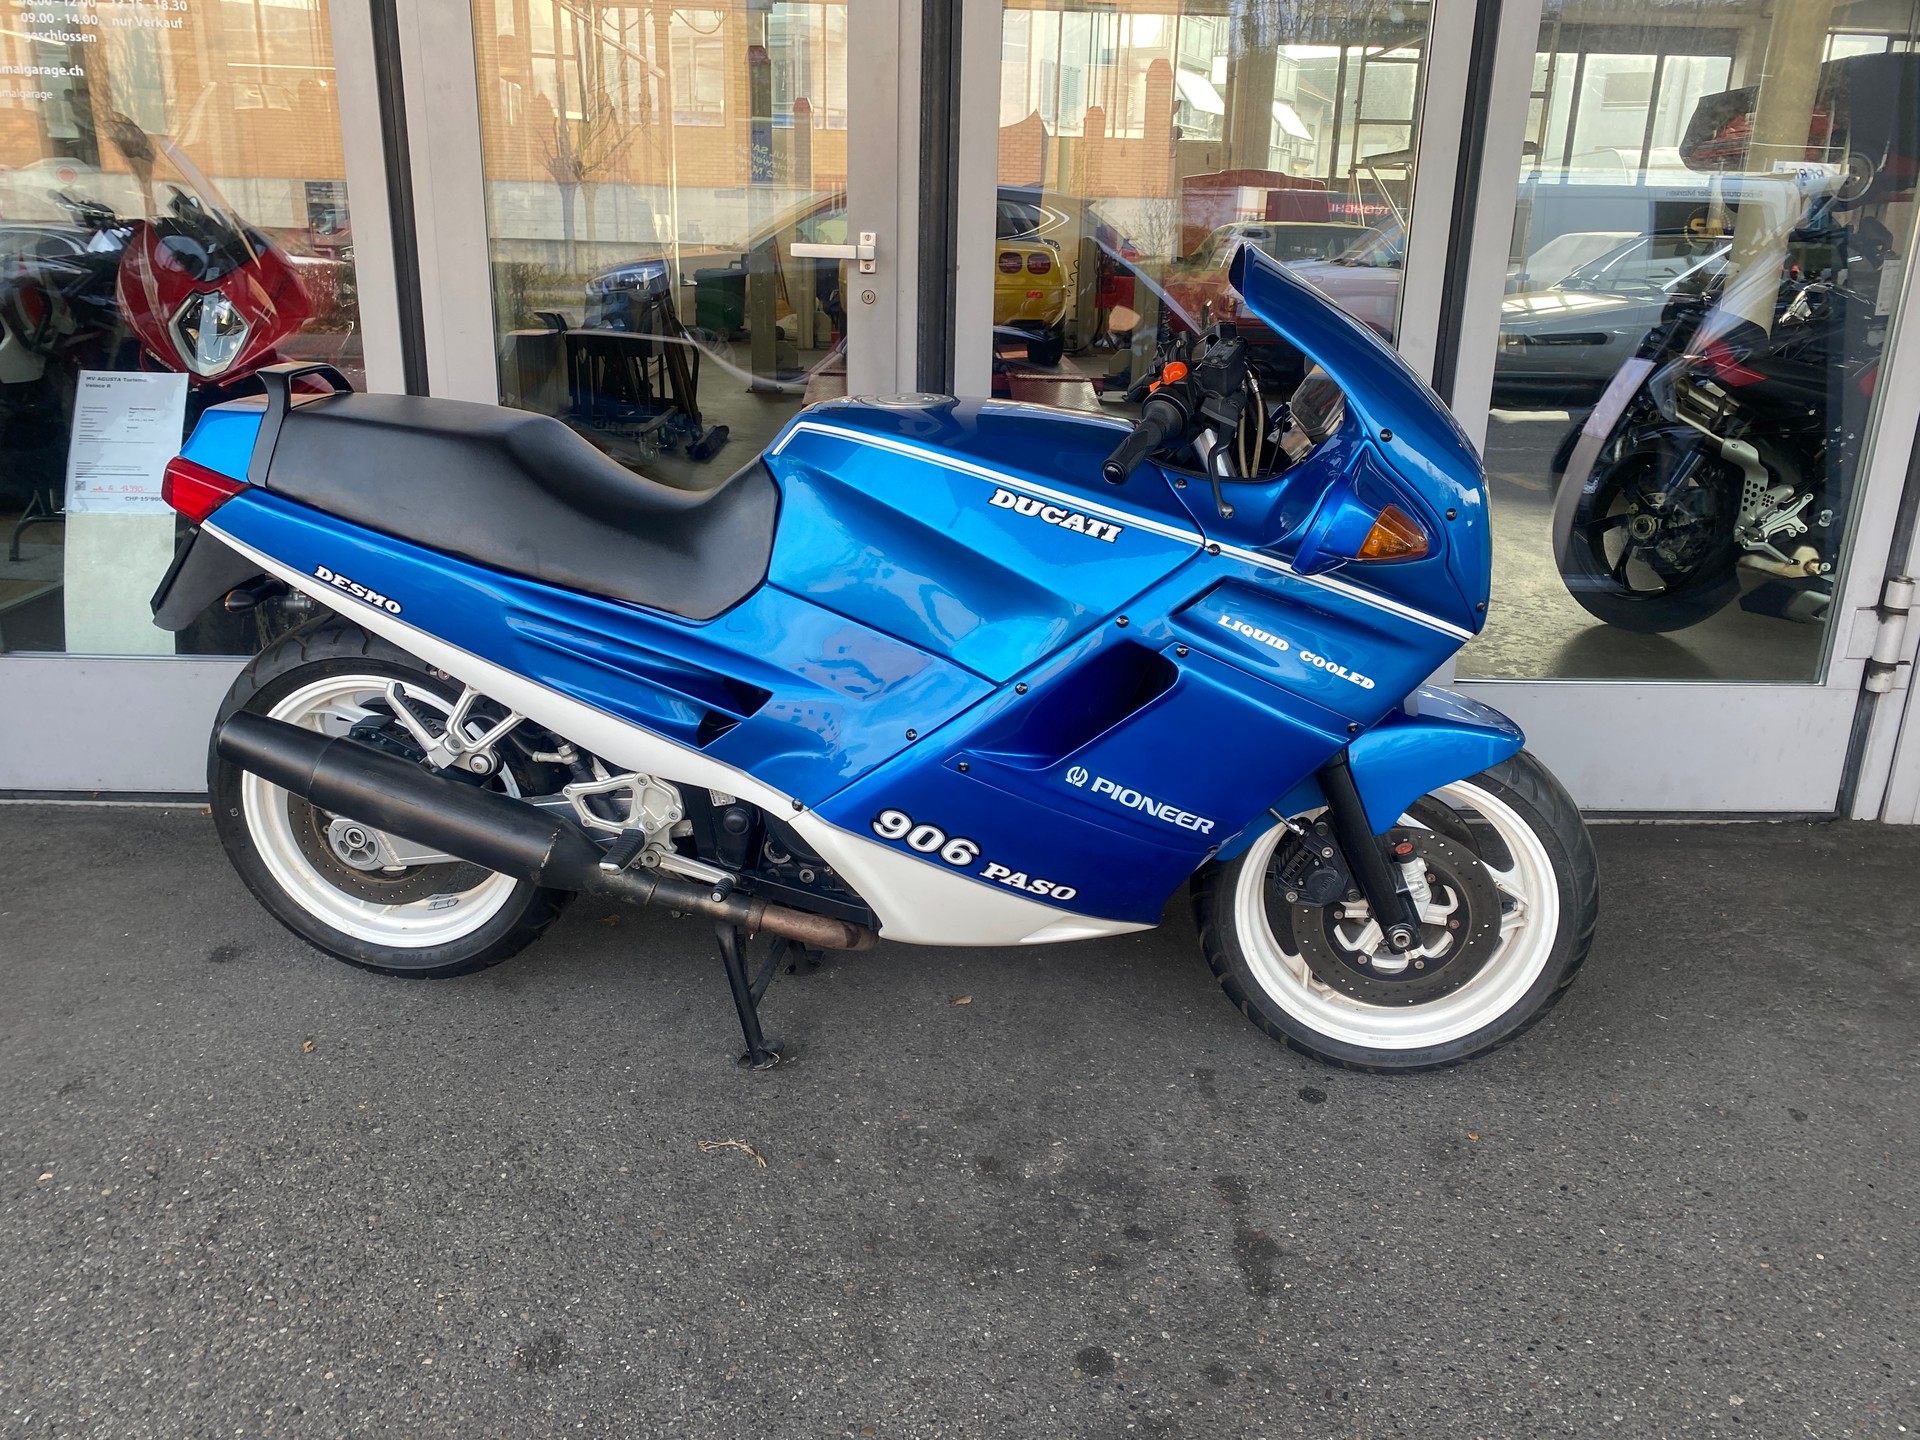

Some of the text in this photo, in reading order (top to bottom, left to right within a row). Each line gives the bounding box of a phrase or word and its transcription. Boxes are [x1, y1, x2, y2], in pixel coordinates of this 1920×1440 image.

[20, 12, 54, 24] 09.00
[65, 13, 99, 26] 14.00
[112, 18, 133, 27] nur
[134, 16, 184, 29] Verkauf
[155, 0, 188, 12] 18.30
[23, 29, 97, 43] geschlossen
[0, 64, 84, 78] malgarage.ch
[988, 487, 1123, 544] DUCATI
[313, 565, 403, 614] DESMO
[1217, 615, 1290, 651] LIQUID
[1299, 650, 1376, 690] COOLED
[1091, 776, 1216, 835] PIONEER
[872, 809, 1077, 901] 906 PASO
